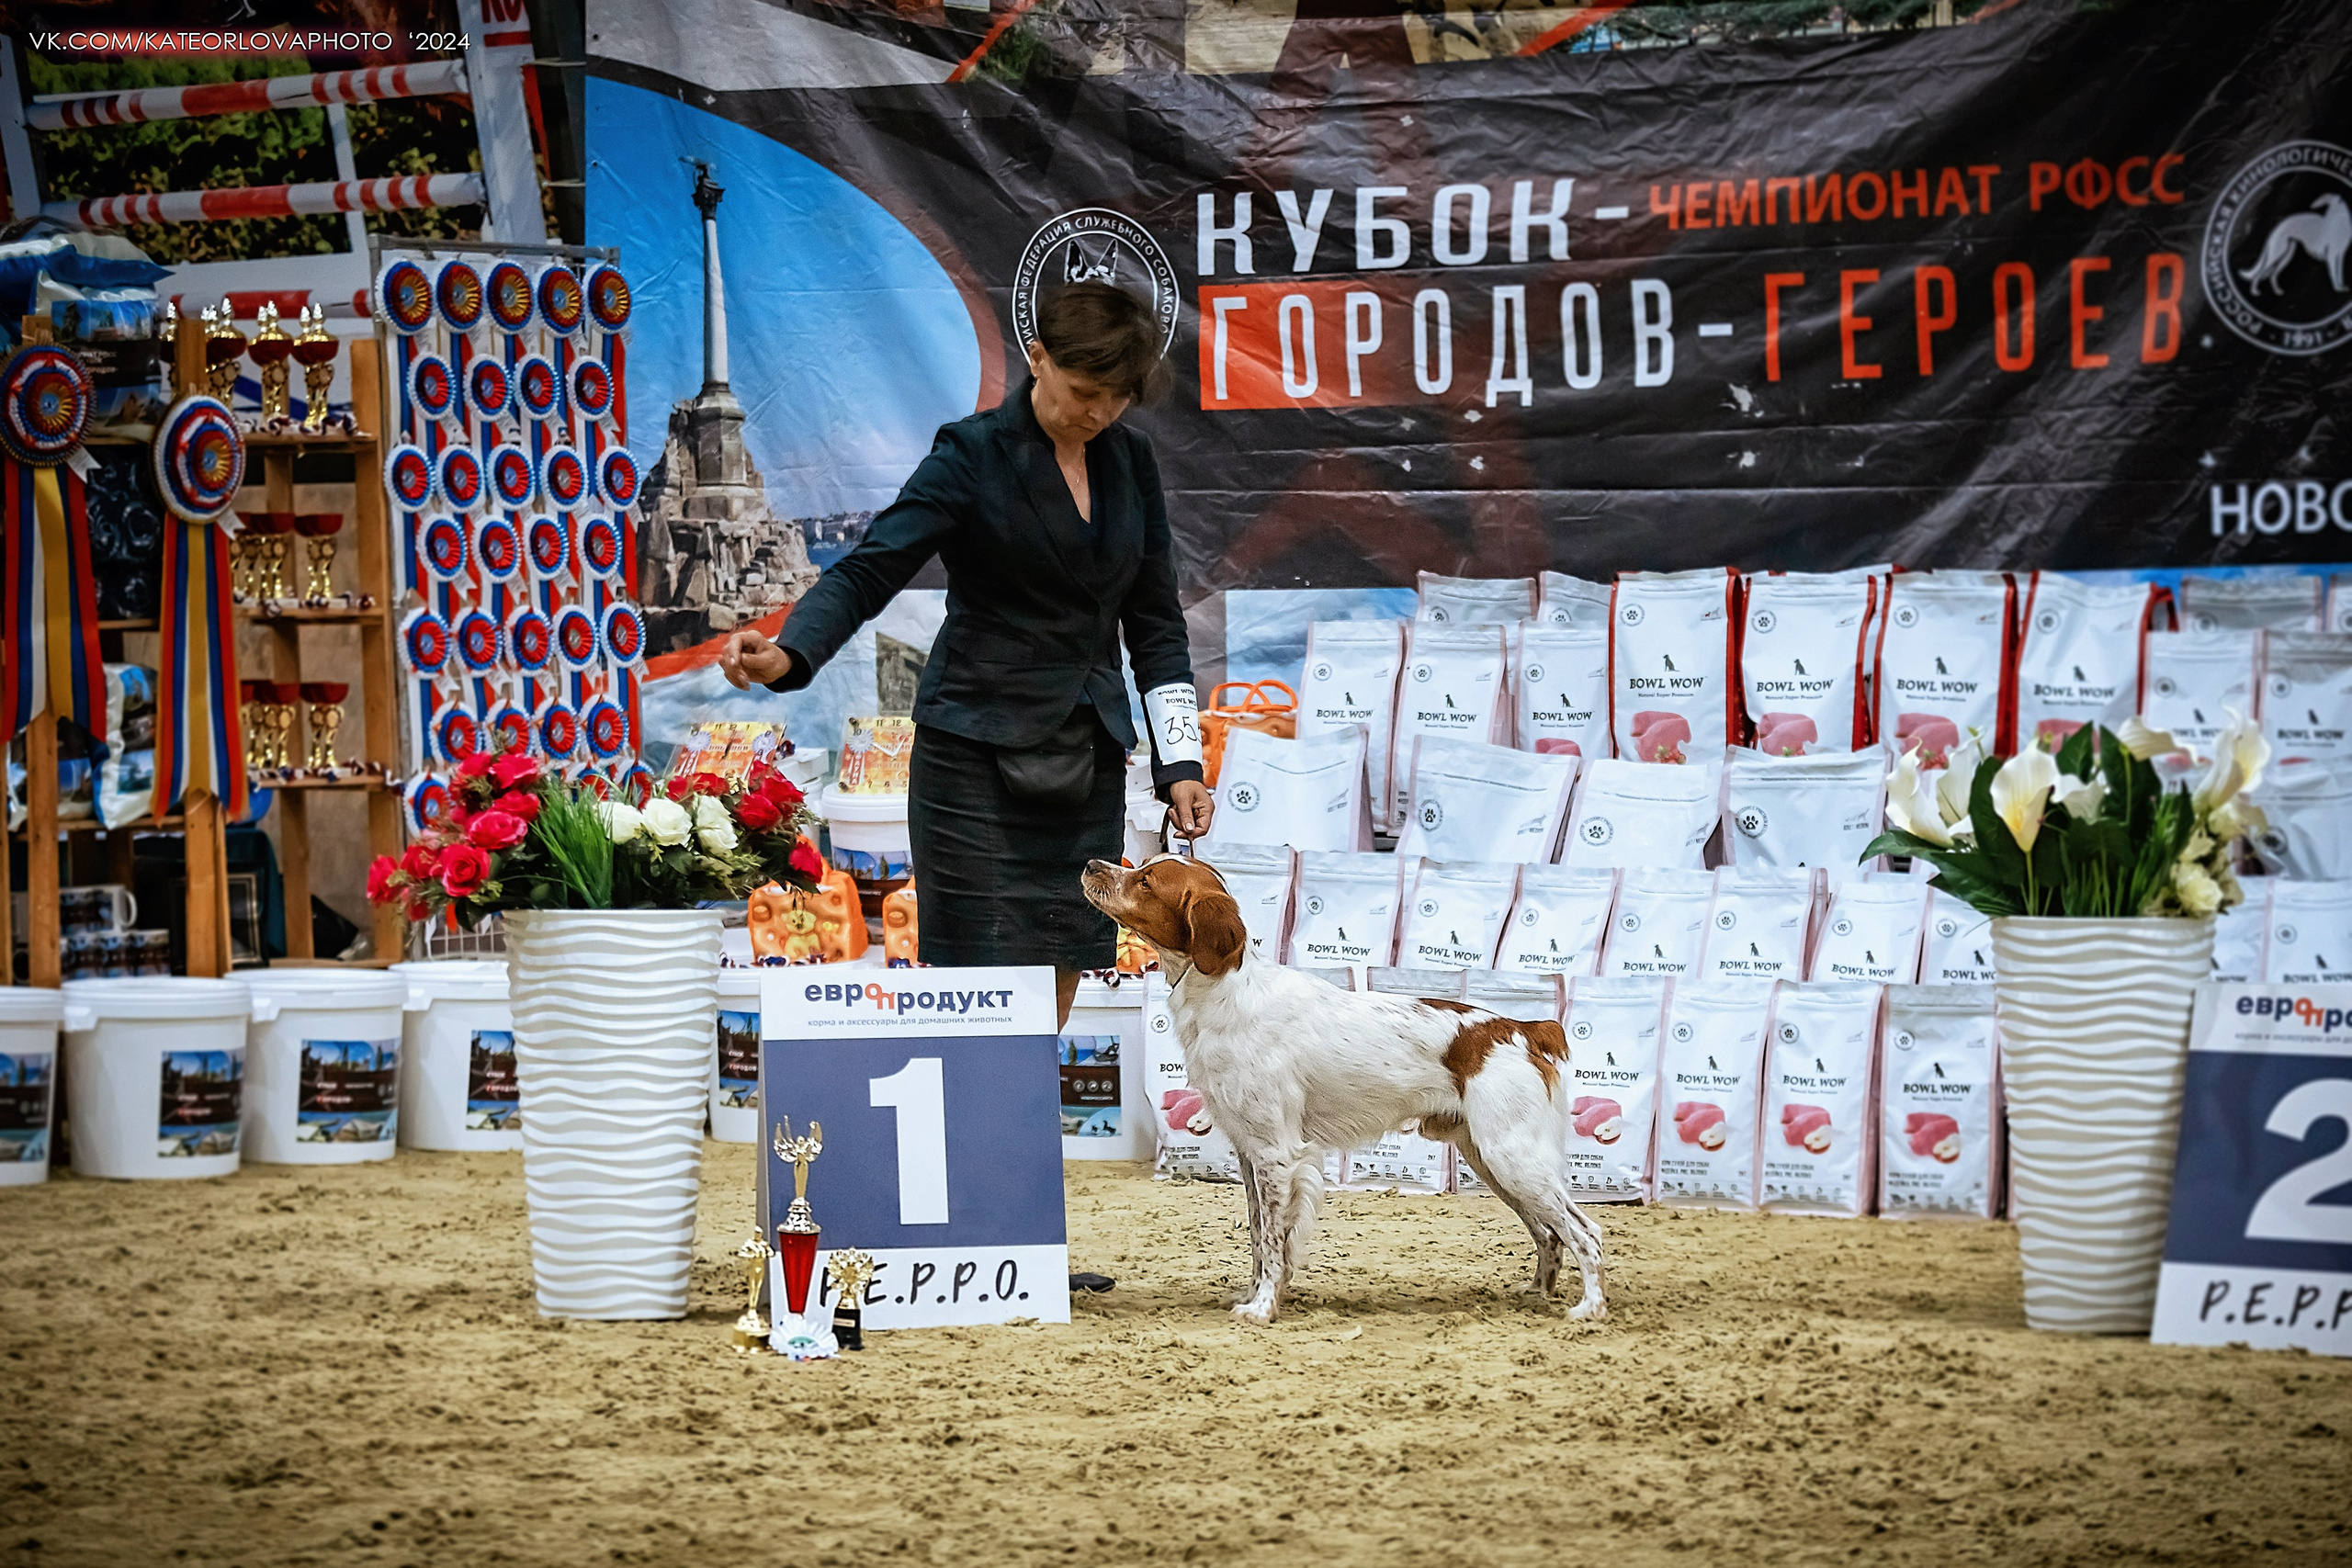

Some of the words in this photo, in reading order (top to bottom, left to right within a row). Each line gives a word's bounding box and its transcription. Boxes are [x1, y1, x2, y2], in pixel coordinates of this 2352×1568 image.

[2230, 147, 2352, 204] КИНОЛОГИЧЕ
[2029, 153, 2186, 212] РФСС
[1020, 220, 1071, 288] ФЕДЕРАЦИЯ
[1074, 215, 1155, 257] СЛУЖЕБНОГО
[2206, 205, 2264, 335] РОССИЙСКАЯ
[1630, 678, 1666, 690] BOWL
[1669, 677, 1704, 689] WOW
[1757, 681, 1795, 692] BOWL
[1800, 679, 1834, 691] WOW
[1896, 679, 1937, 693] BOWL
[1941, 681, 1978, 694] WOW
[2034, 684, 2074, 697] BOWL
[2078, 686, 2115, 698] WOW
[1317, 709, 1346, 718] BOWL
[1350, 710, 1374, 719] WOW
[1417, 712, 1447, 721] BOWL
[1450, 714, 1477, 723] WOW
[1532, 712, 1565, 721] BOWL
[1567, 711, 1593, 721] WOW
[1165, 716, 1198, 745] 35
[1307, 943, 1338, 953] BOWL
[1341, 945, 1372, 956] WOW
[1419, 945, 1450, 959] BOWL
[1453, 950, 1482, 962] WOW
[1519, 954, 1548, 964] BOWL
[1552, 954, 1576, 965] WOW
[1623, 962, 1655, 972] BOWL
[1658, 964, 1687, 973] WOW
[1719, 961, 1750, 970] BOWL
[1754, 962, 1782, 972] WOW
[1831, 964, 1865, 976] BOWL
[1869, 967, 1897, 978] WOW
[1942, 969, 1977, 980] BOWL
[804, 982, 1013, 1015] европродукт
[808, 1019, 837, 1027] корма
[846, 1019, 899, 1027] аксессуары
[918, 1017, 966, 1025] домашних
[1159, 1064, 1187, 1073] BOW
[1575, 1069, 1608, 1080] BOWL
[1611, 1071, 1640, 1082] WOW
[1676, 1074, 1710, 1085] BOWL
[1713, 1076, 1741, 1086] WOW
[1783, 1076, 1817, 1087] BOWL
[1820, 1077, 1847, 1088] WOW
[1904, 1084, 1938, 1093] BOWL
[1940, 1084, 1972, 1094] WOW
[869, 1057, 950, 1225] 1
[2245, 1077, 2352, 1245] 2
